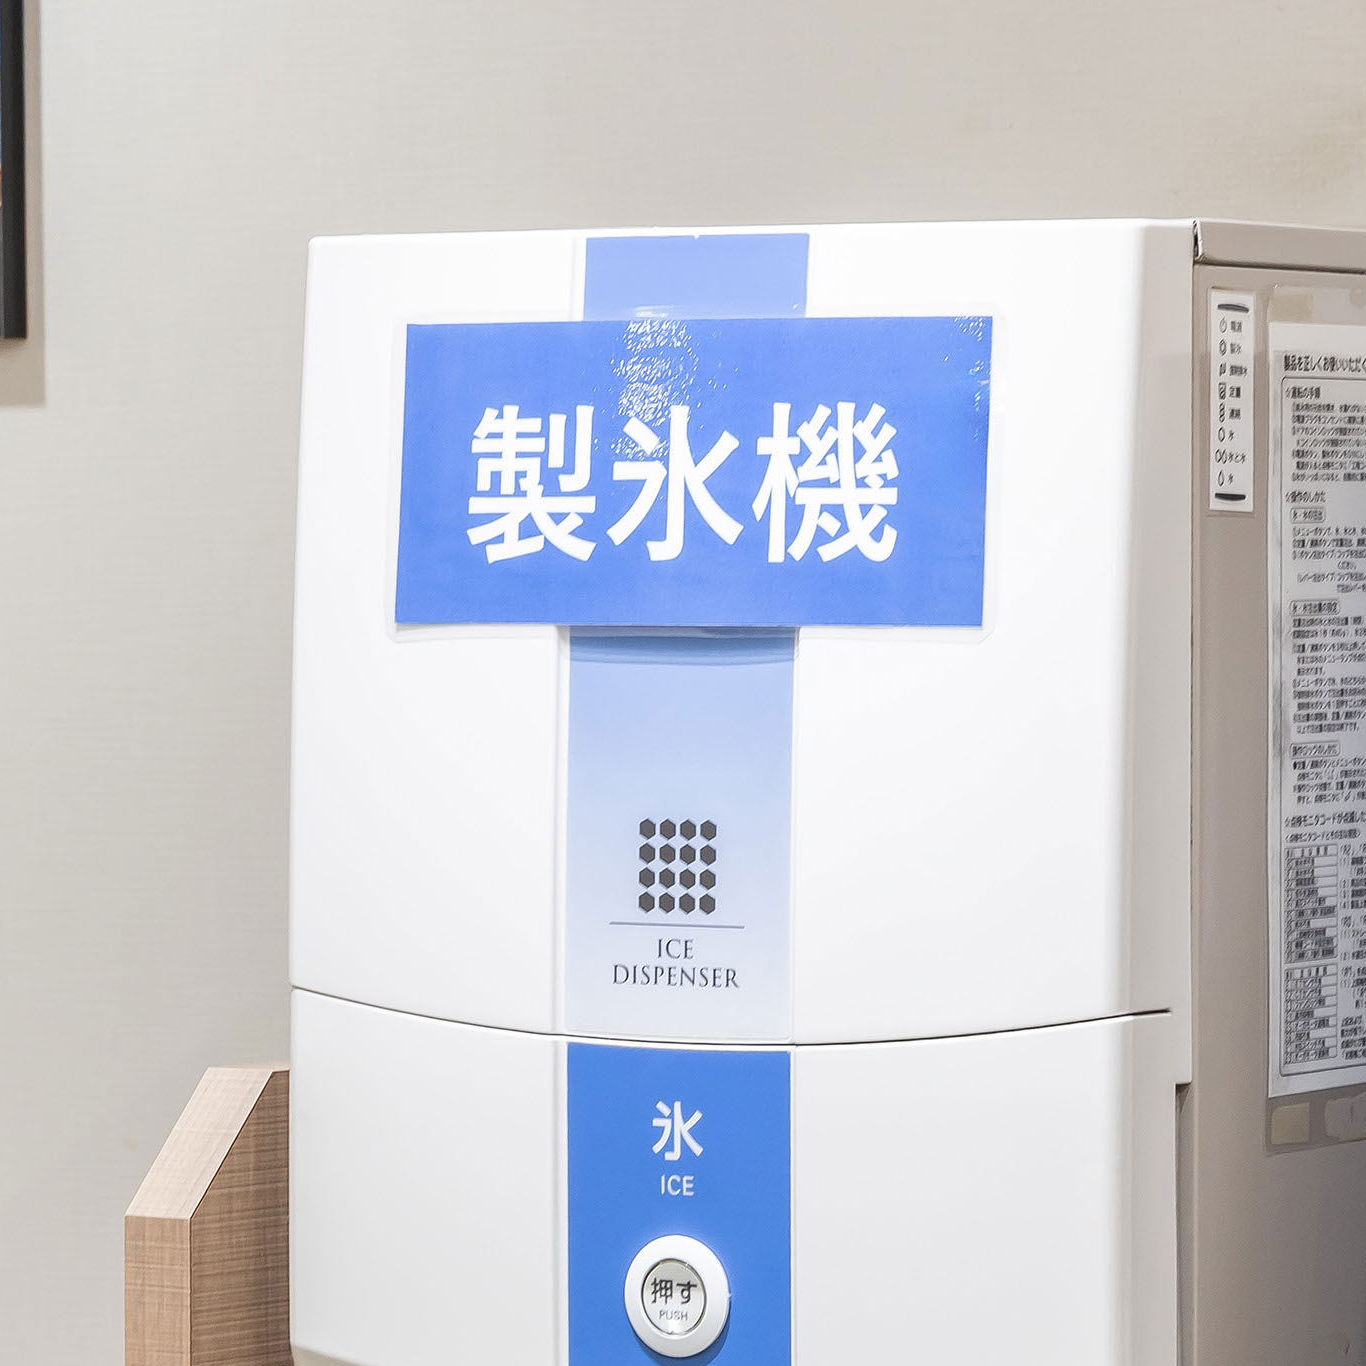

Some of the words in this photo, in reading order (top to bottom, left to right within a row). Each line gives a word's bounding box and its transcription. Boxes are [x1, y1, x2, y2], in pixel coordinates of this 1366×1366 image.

[467, 402, 899, 564] 製氷機
[657, 938, 694, 959] ICE
[612, 964, 739, 988] DISPENSER
[652, 1100, 704, 1161] 氷
[660, 1175, 695, 1197] ICE
[651, 1277, 698, 1306] 押す
[659, 1308, 689, 1322] PUSH
